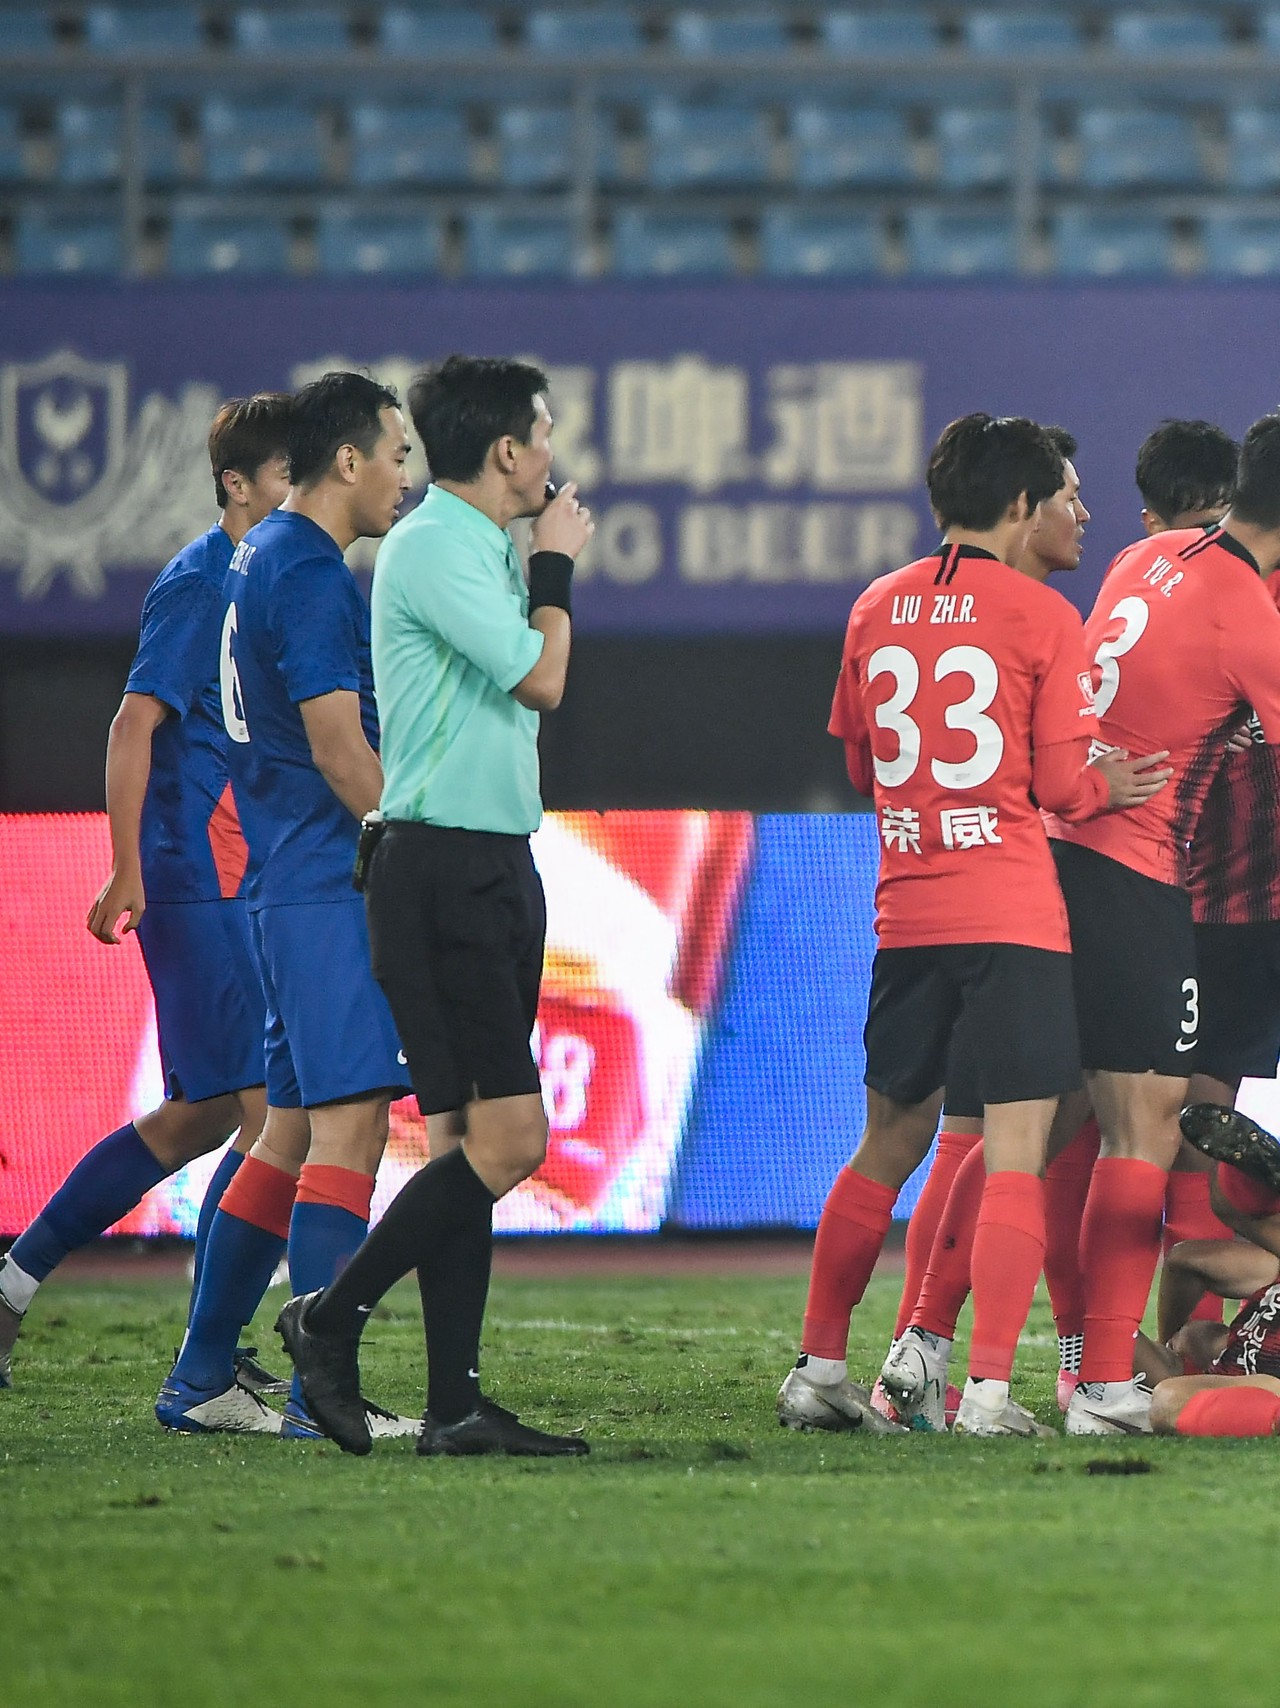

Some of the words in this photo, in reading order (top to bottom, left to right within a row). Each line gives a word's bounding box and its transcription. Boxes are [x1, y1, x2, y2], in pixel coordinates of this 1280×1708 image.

[1143, 555, 1173, 586] YU
[890, 595, 922, 624] LIU
[930, 594, 977, 624] ZH.R.
[1093, 596, 1149, 718] 3
[867, 645, 1004, 790] 33
[881, 805, 1002, 855] 荣威
[1180, 976, 1200, 1035] 3
